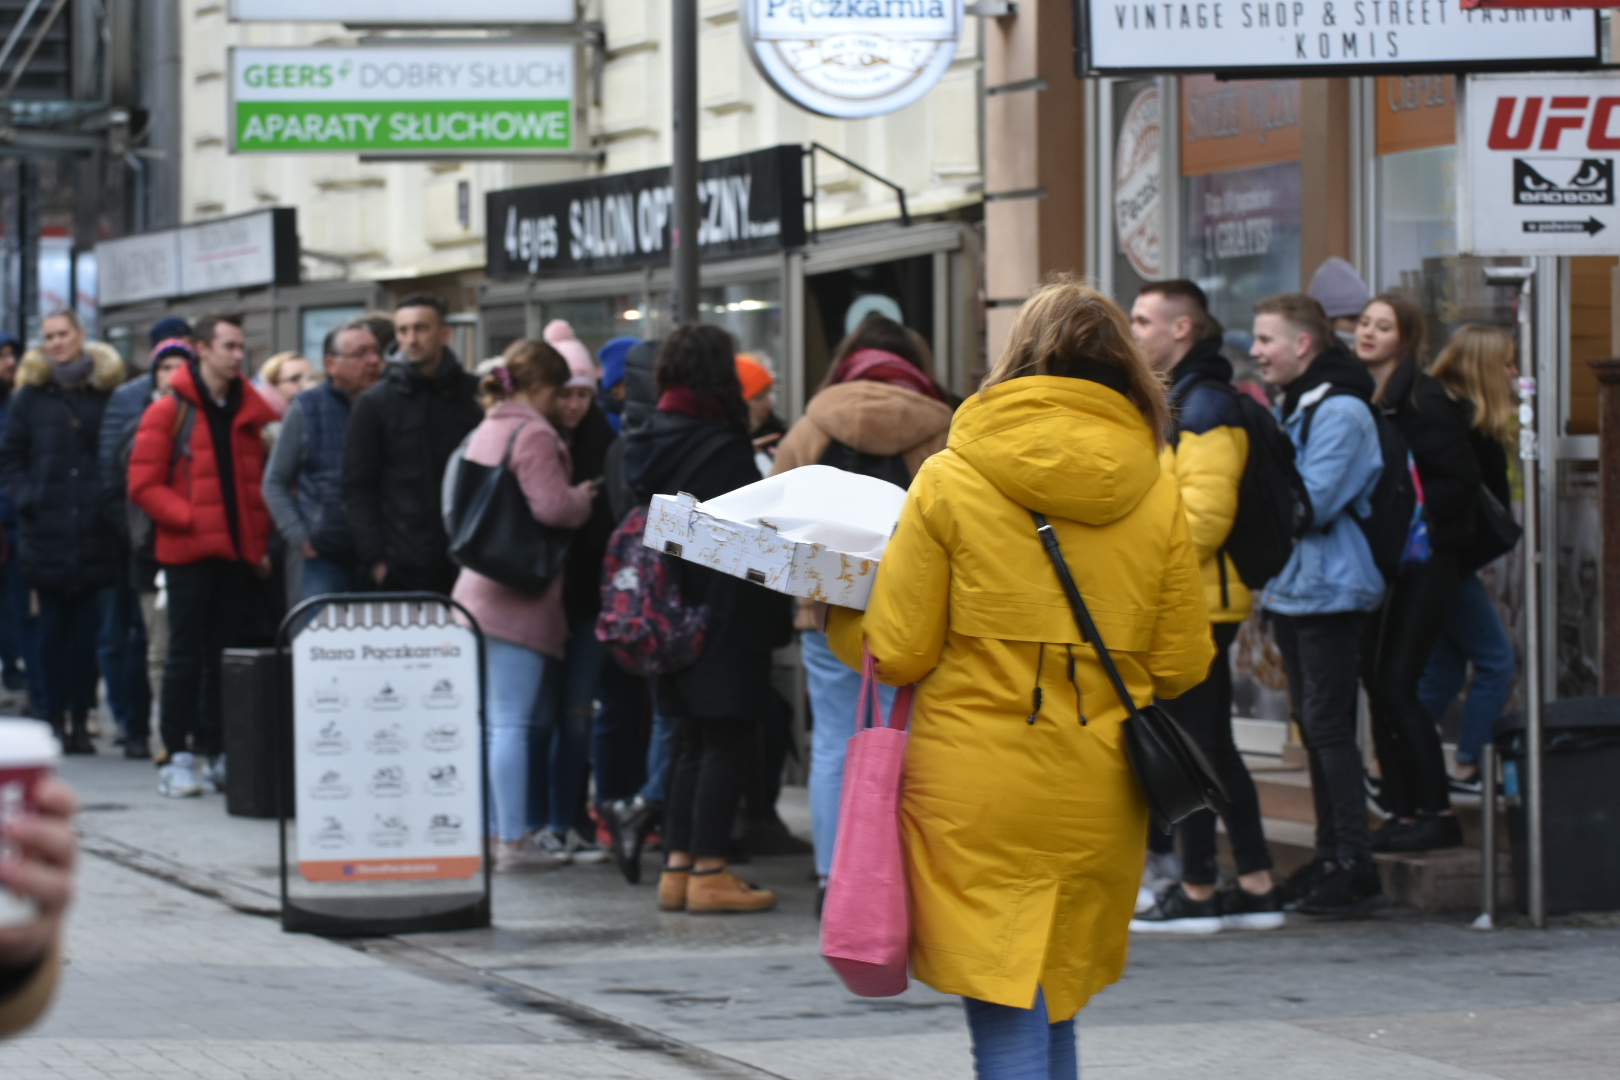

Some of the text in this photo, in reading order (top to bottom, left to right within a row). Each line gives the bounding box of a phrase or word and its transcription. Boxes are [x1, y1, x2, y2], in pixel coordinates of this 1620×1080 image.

[766, 0, 945, 24] Pączkarnia
[1114, 4, 1223, 30] VINTAGE
[1241, 1, 1303, 29] SHOP
[1322, 1, 1337, 27] &
[1354, 0, 1449, 26] STREET
[1295, 31, 1399, 59] KOMIS
[244, 61, 566, 89] GEERS DOBRY SŁUCH
[242, 111, 567, 143] APARATY SŁUCHOWE
[1487, 96, 1620, 151] UFC
[568, 196, 636, 261] SALON
[310, 644, 356, 662] Stara
